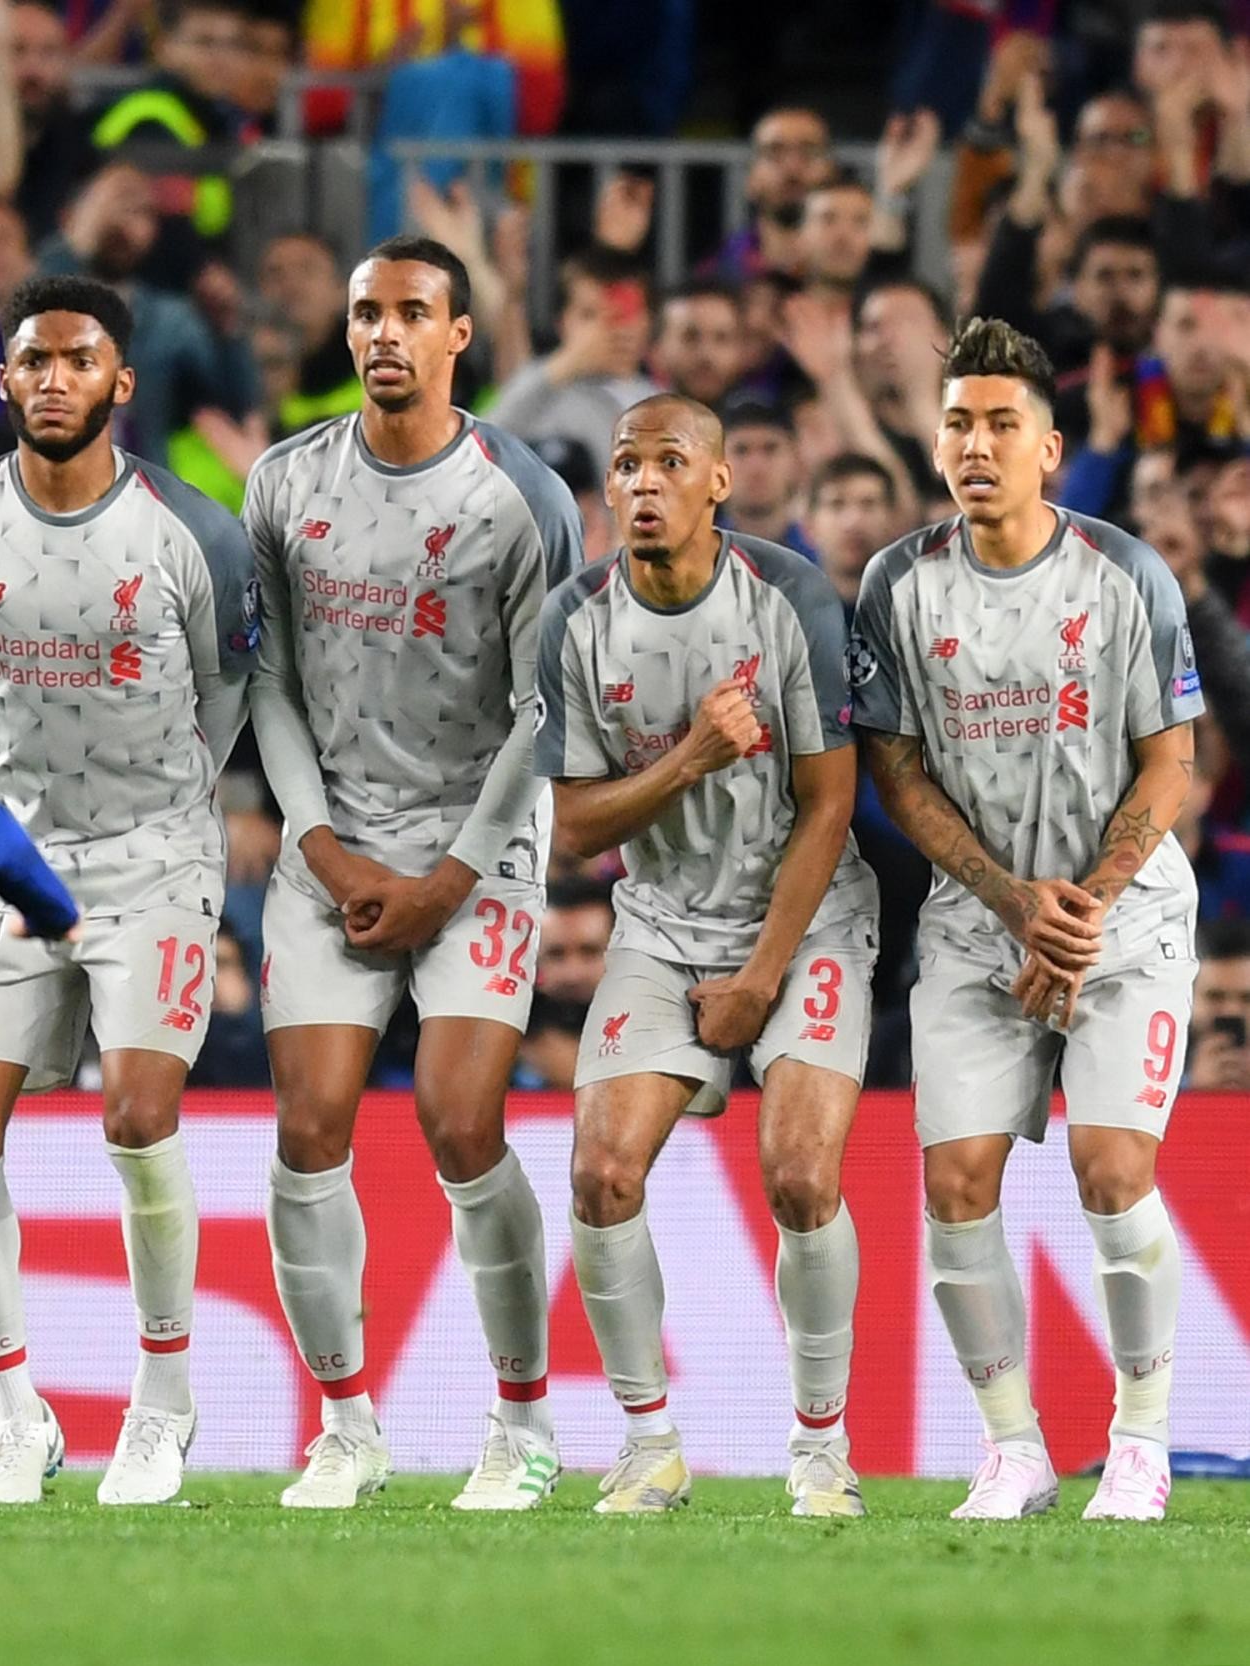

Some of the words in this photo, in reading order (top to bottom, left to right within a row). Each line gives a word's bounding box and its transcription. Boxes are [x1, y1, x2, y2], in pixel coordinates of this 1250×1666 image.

[303, 570, 407, 607] Standard
[943, 682, 1051, 712] Standard
[943, 714, 1051, 741] Chartered
[469, 897, 535, 982] 32
[156, 935, 206, 1017] 12
[803, 957, 843, 1021] 3
[1142, 1010, 1176, 1084] 9
